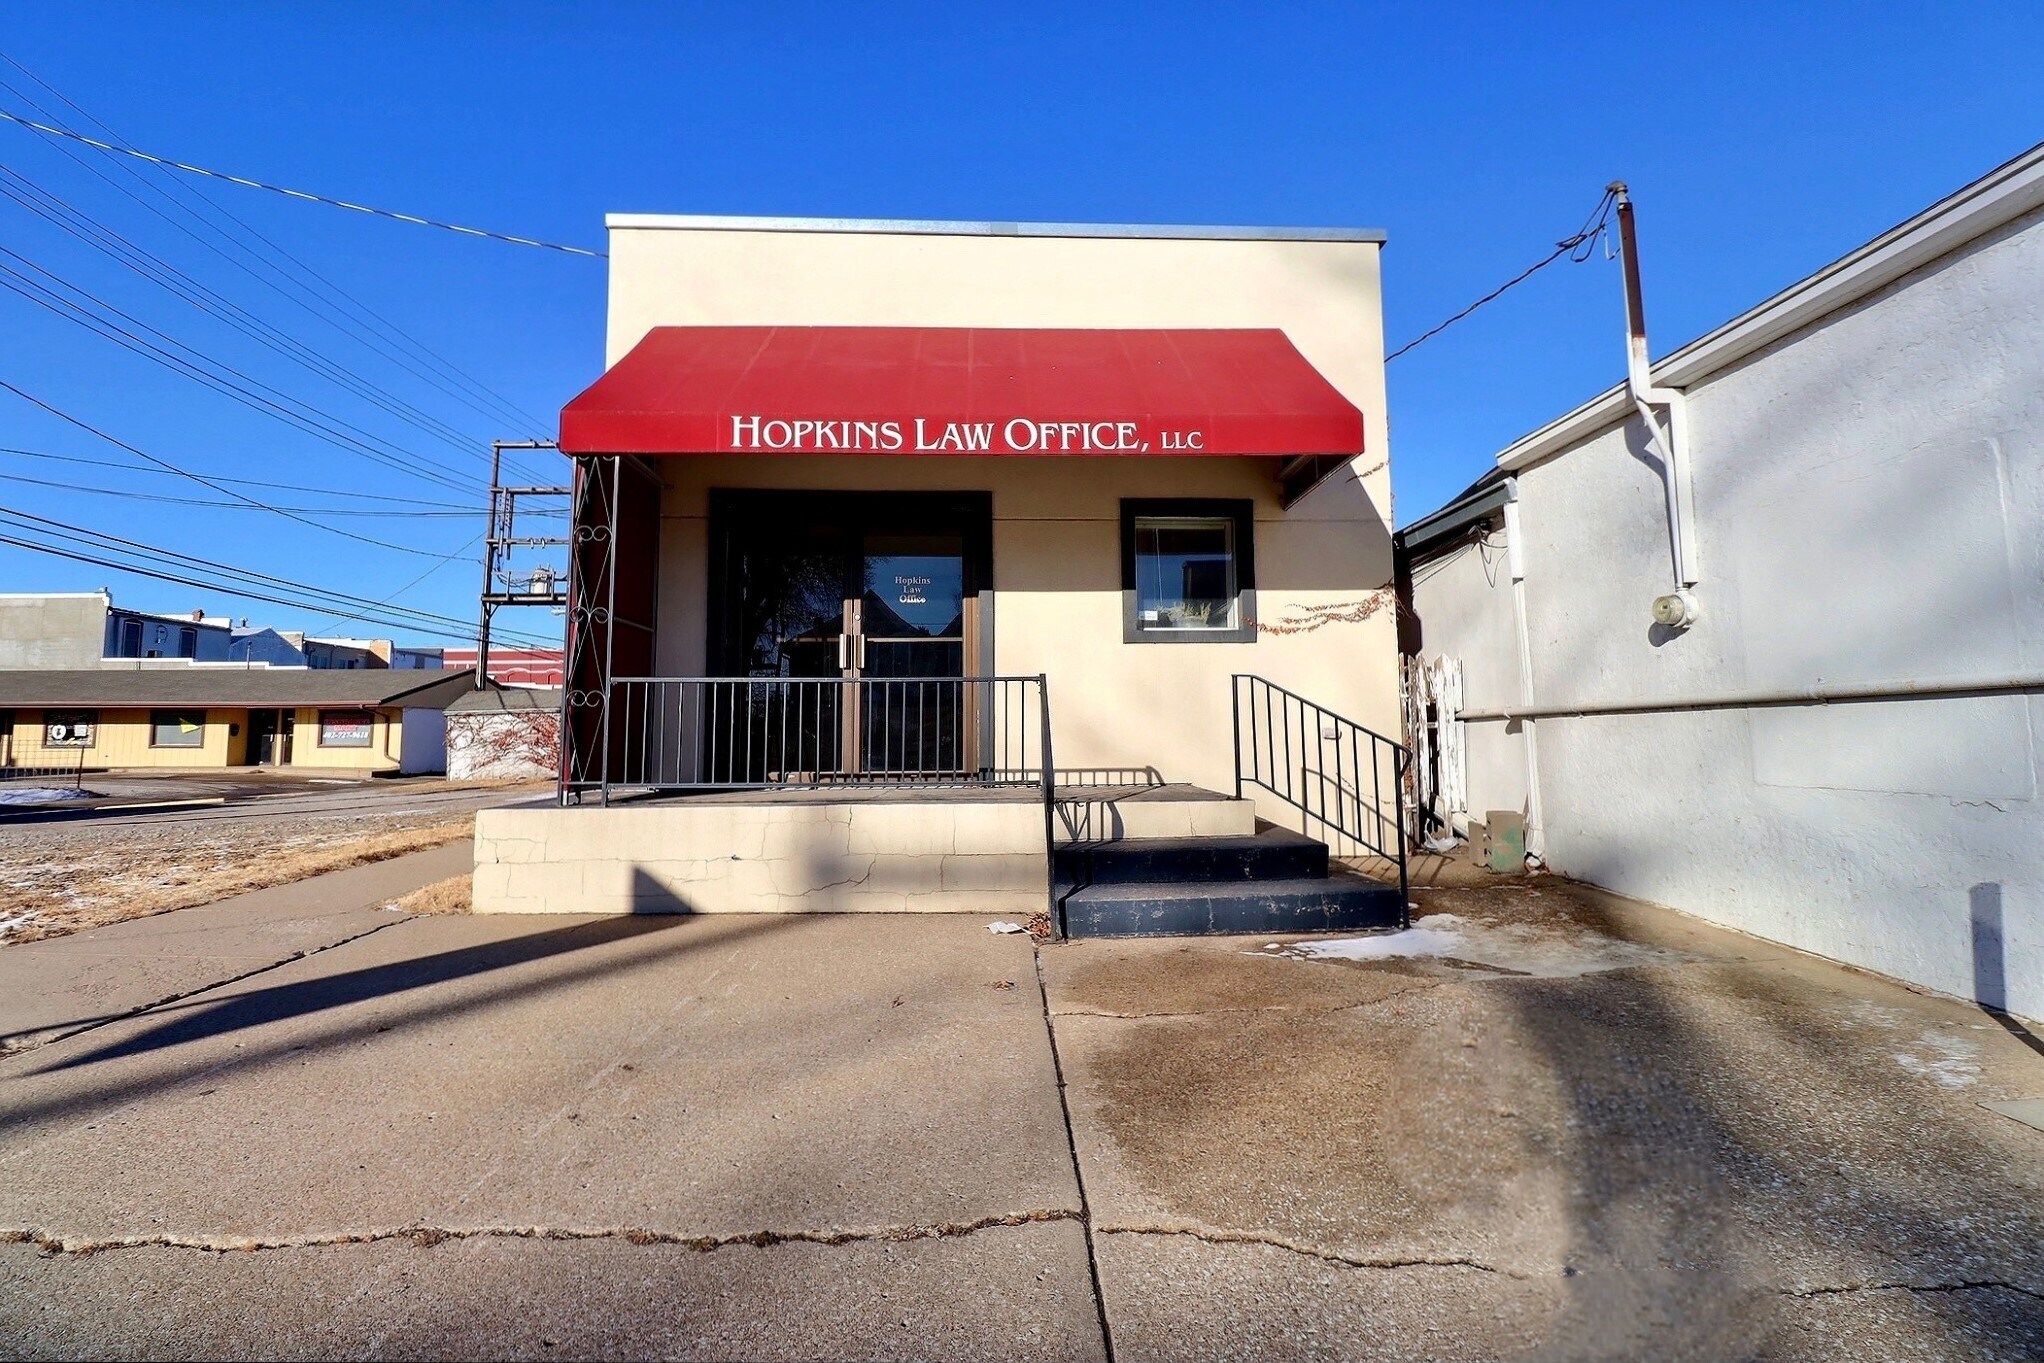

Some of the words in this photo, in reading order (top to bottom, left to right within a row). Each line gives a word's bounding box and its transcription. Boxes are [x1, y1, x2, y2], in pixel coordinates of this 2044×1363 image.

[730, 415, 903, 451] HOPKINS
[914, 418, 995, 451] LAW
[1003, 418, 1150, 453] OFFICE,
[1160, 431, 1204, 450] LLC
[894, 576, 931, 585] Hopkins
[903, 586, 921, 594] Law
[899, 594, 926, 603] Office
